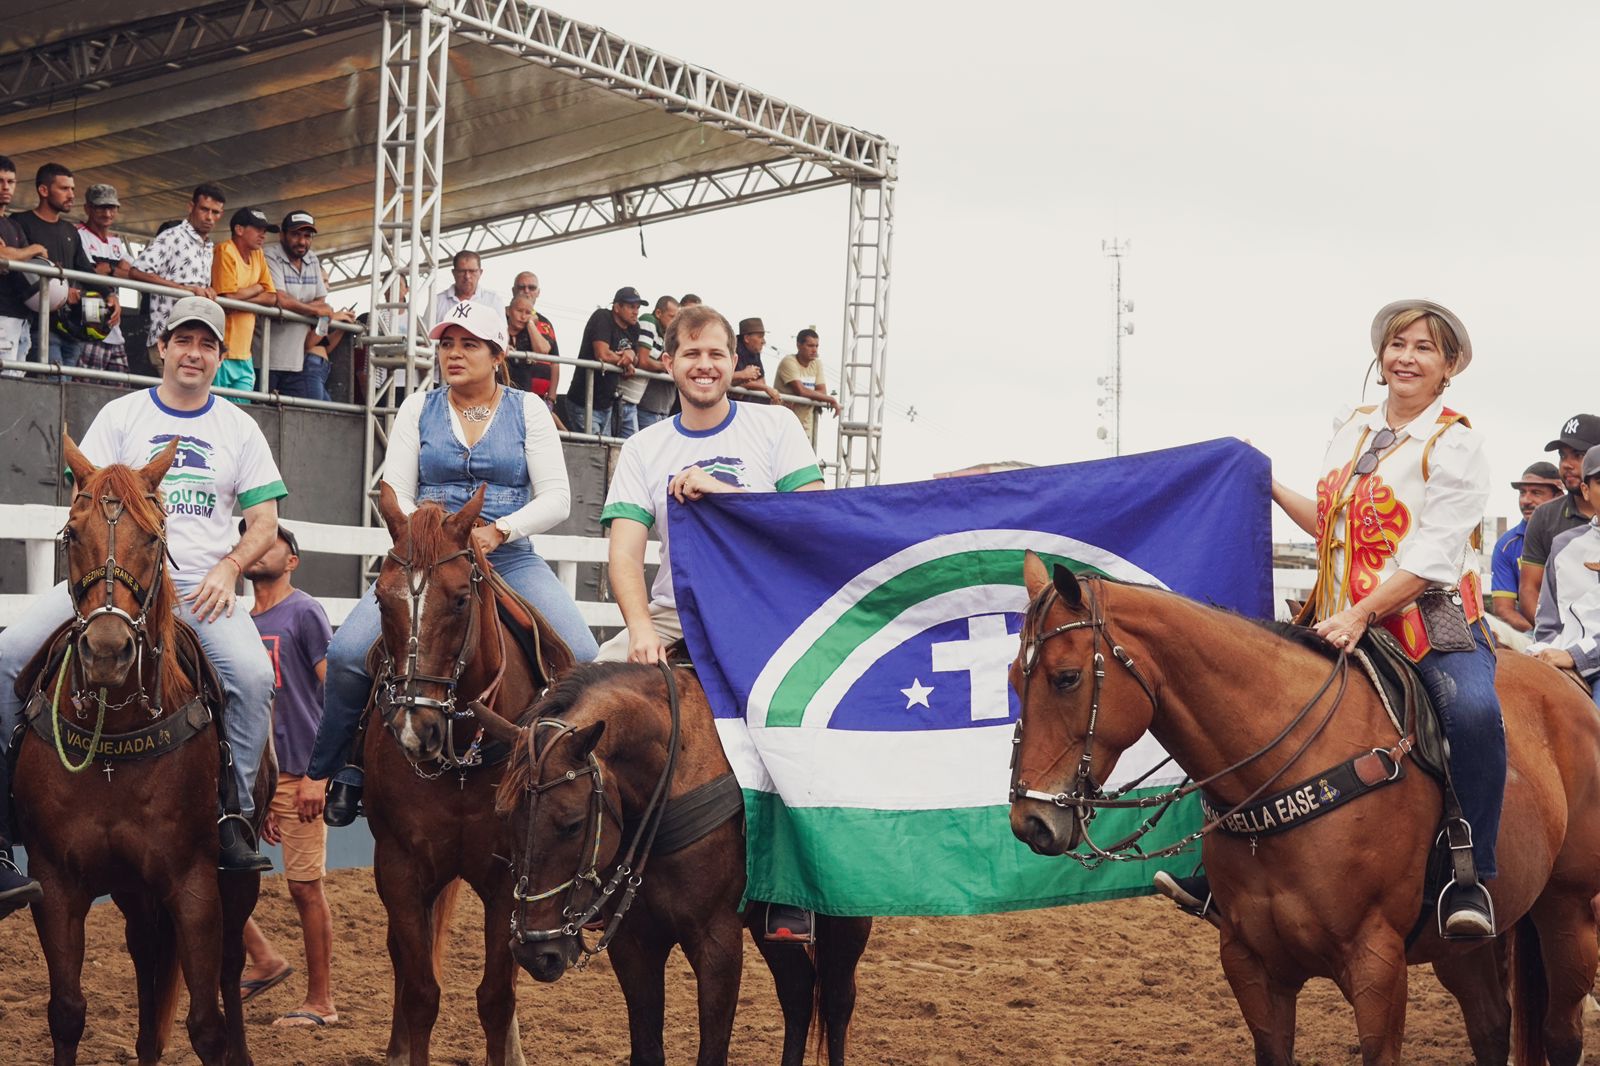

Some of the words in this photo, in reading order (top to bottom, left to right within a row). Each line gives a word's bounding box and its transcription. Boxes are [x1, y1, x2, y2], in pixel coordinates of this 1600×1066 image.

[453, 303, 472, 318] NY
[1564, 418, 1580, 434] NY
[195, 491, 217, 507] DE
[164, 503, 214, 519] URUBIM
[1226, 806, 1277, 833] BELLA
[1274, 785, 1321, 824] EASE
